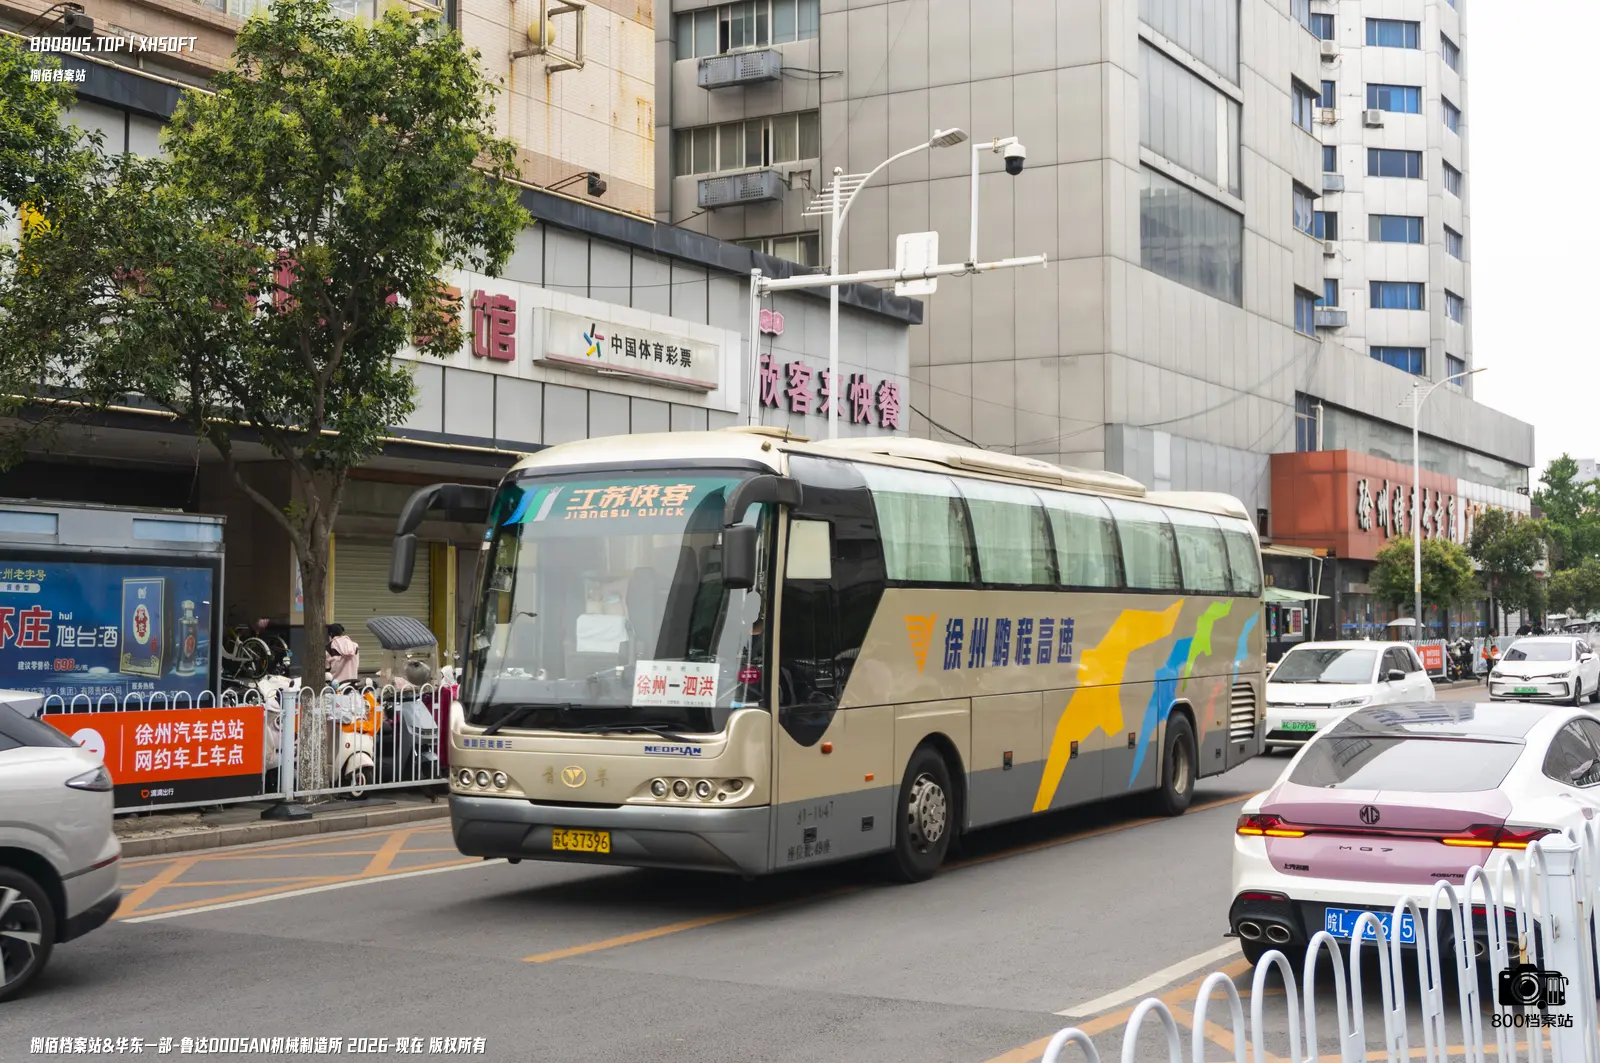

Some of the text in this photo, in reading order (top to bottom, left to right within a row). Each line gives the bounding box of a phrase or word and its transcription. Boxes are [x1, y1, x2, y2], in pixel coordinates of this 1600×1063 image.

[611, 333, 692, 368] 中国体育彩票
[566, 484, 695, 511] 江苏快客
[0, 568, 47, 581] 州老字号
[59, 612, 72, 620] hui
[943, 617, 1075, 671] 徐州鹏程高速
[135, 719, 245, 746] 徐州汽车总站
[135, 744, 244, 772] 网约车上车点
[644, 745, 702, 756] NEOPLAN
[150, 788, 174, 797] 滴滴出行
[1360, 805, 1380, 825] MG
